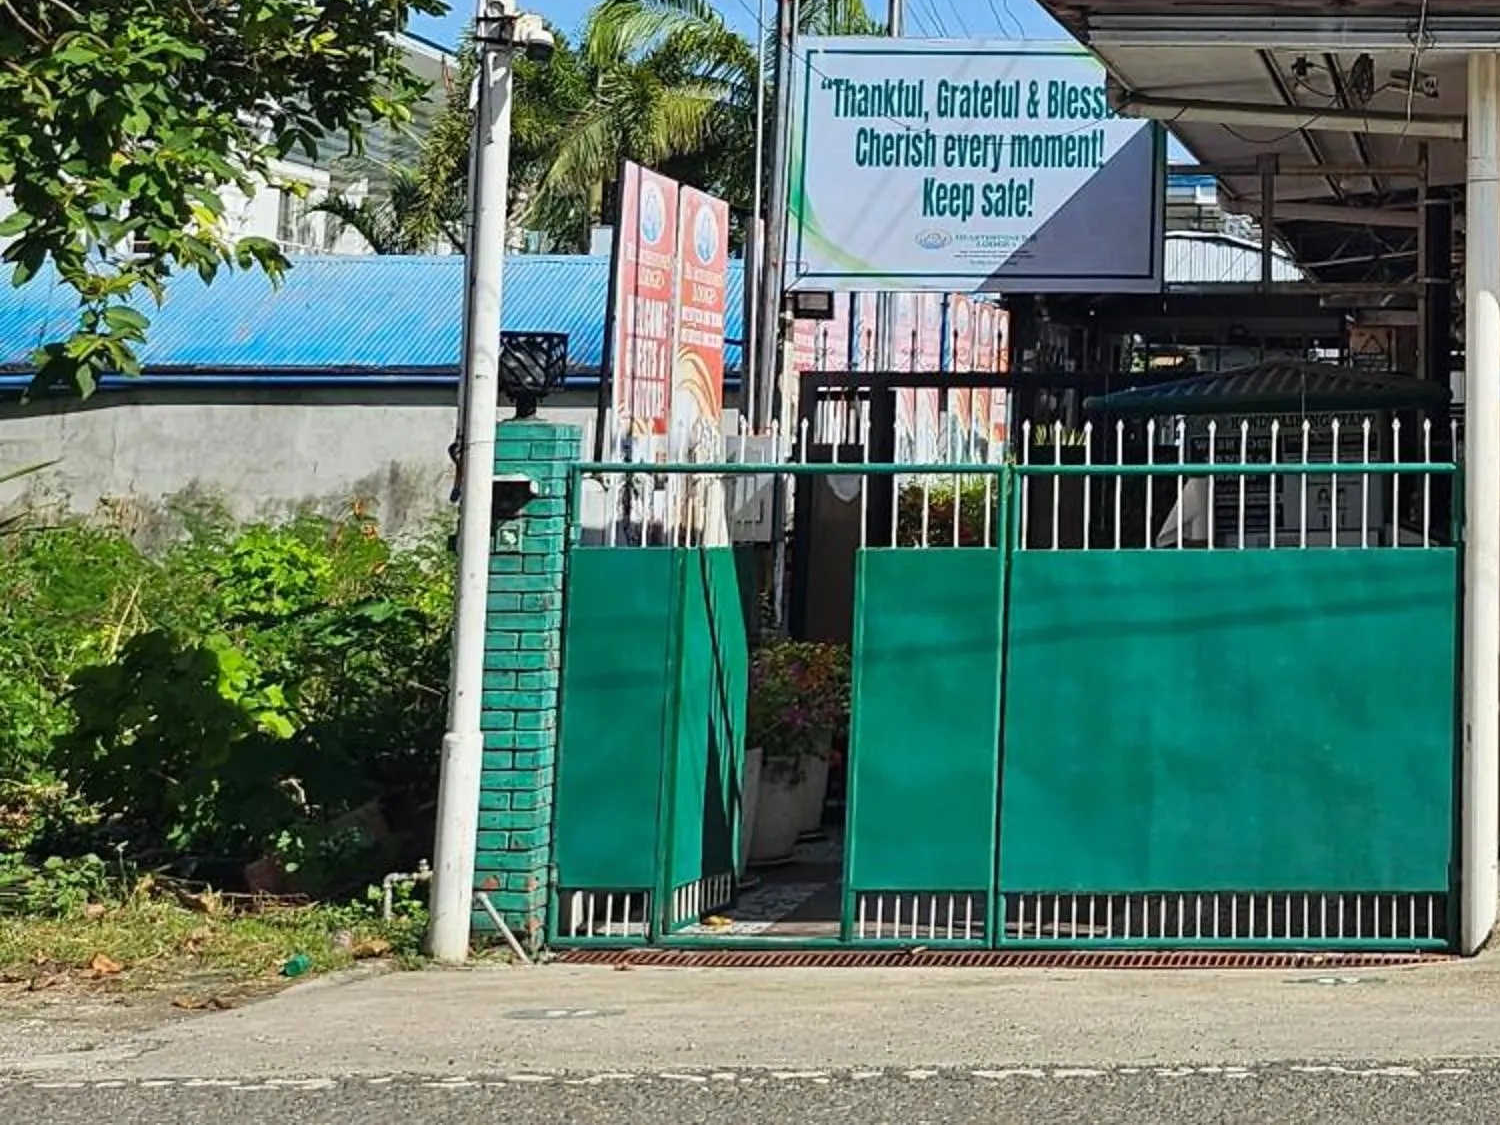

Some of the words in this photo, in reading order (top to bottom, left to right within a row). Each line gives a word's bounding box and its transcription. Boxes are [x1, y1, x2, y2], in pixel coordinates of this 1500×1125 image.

[937, 79, 1020, 118] Grateful
[1027, 80, 1040, 118] &
[1047, 80, 1129, 119] Bless
[855, 127, 936, 168] Cherish
[943, 134, 1004, 174] every
[1009, 129, 1105, 169] moment!
[922, 177, 975, 222] Keep
[981, 177, 1034, 218] safe!
